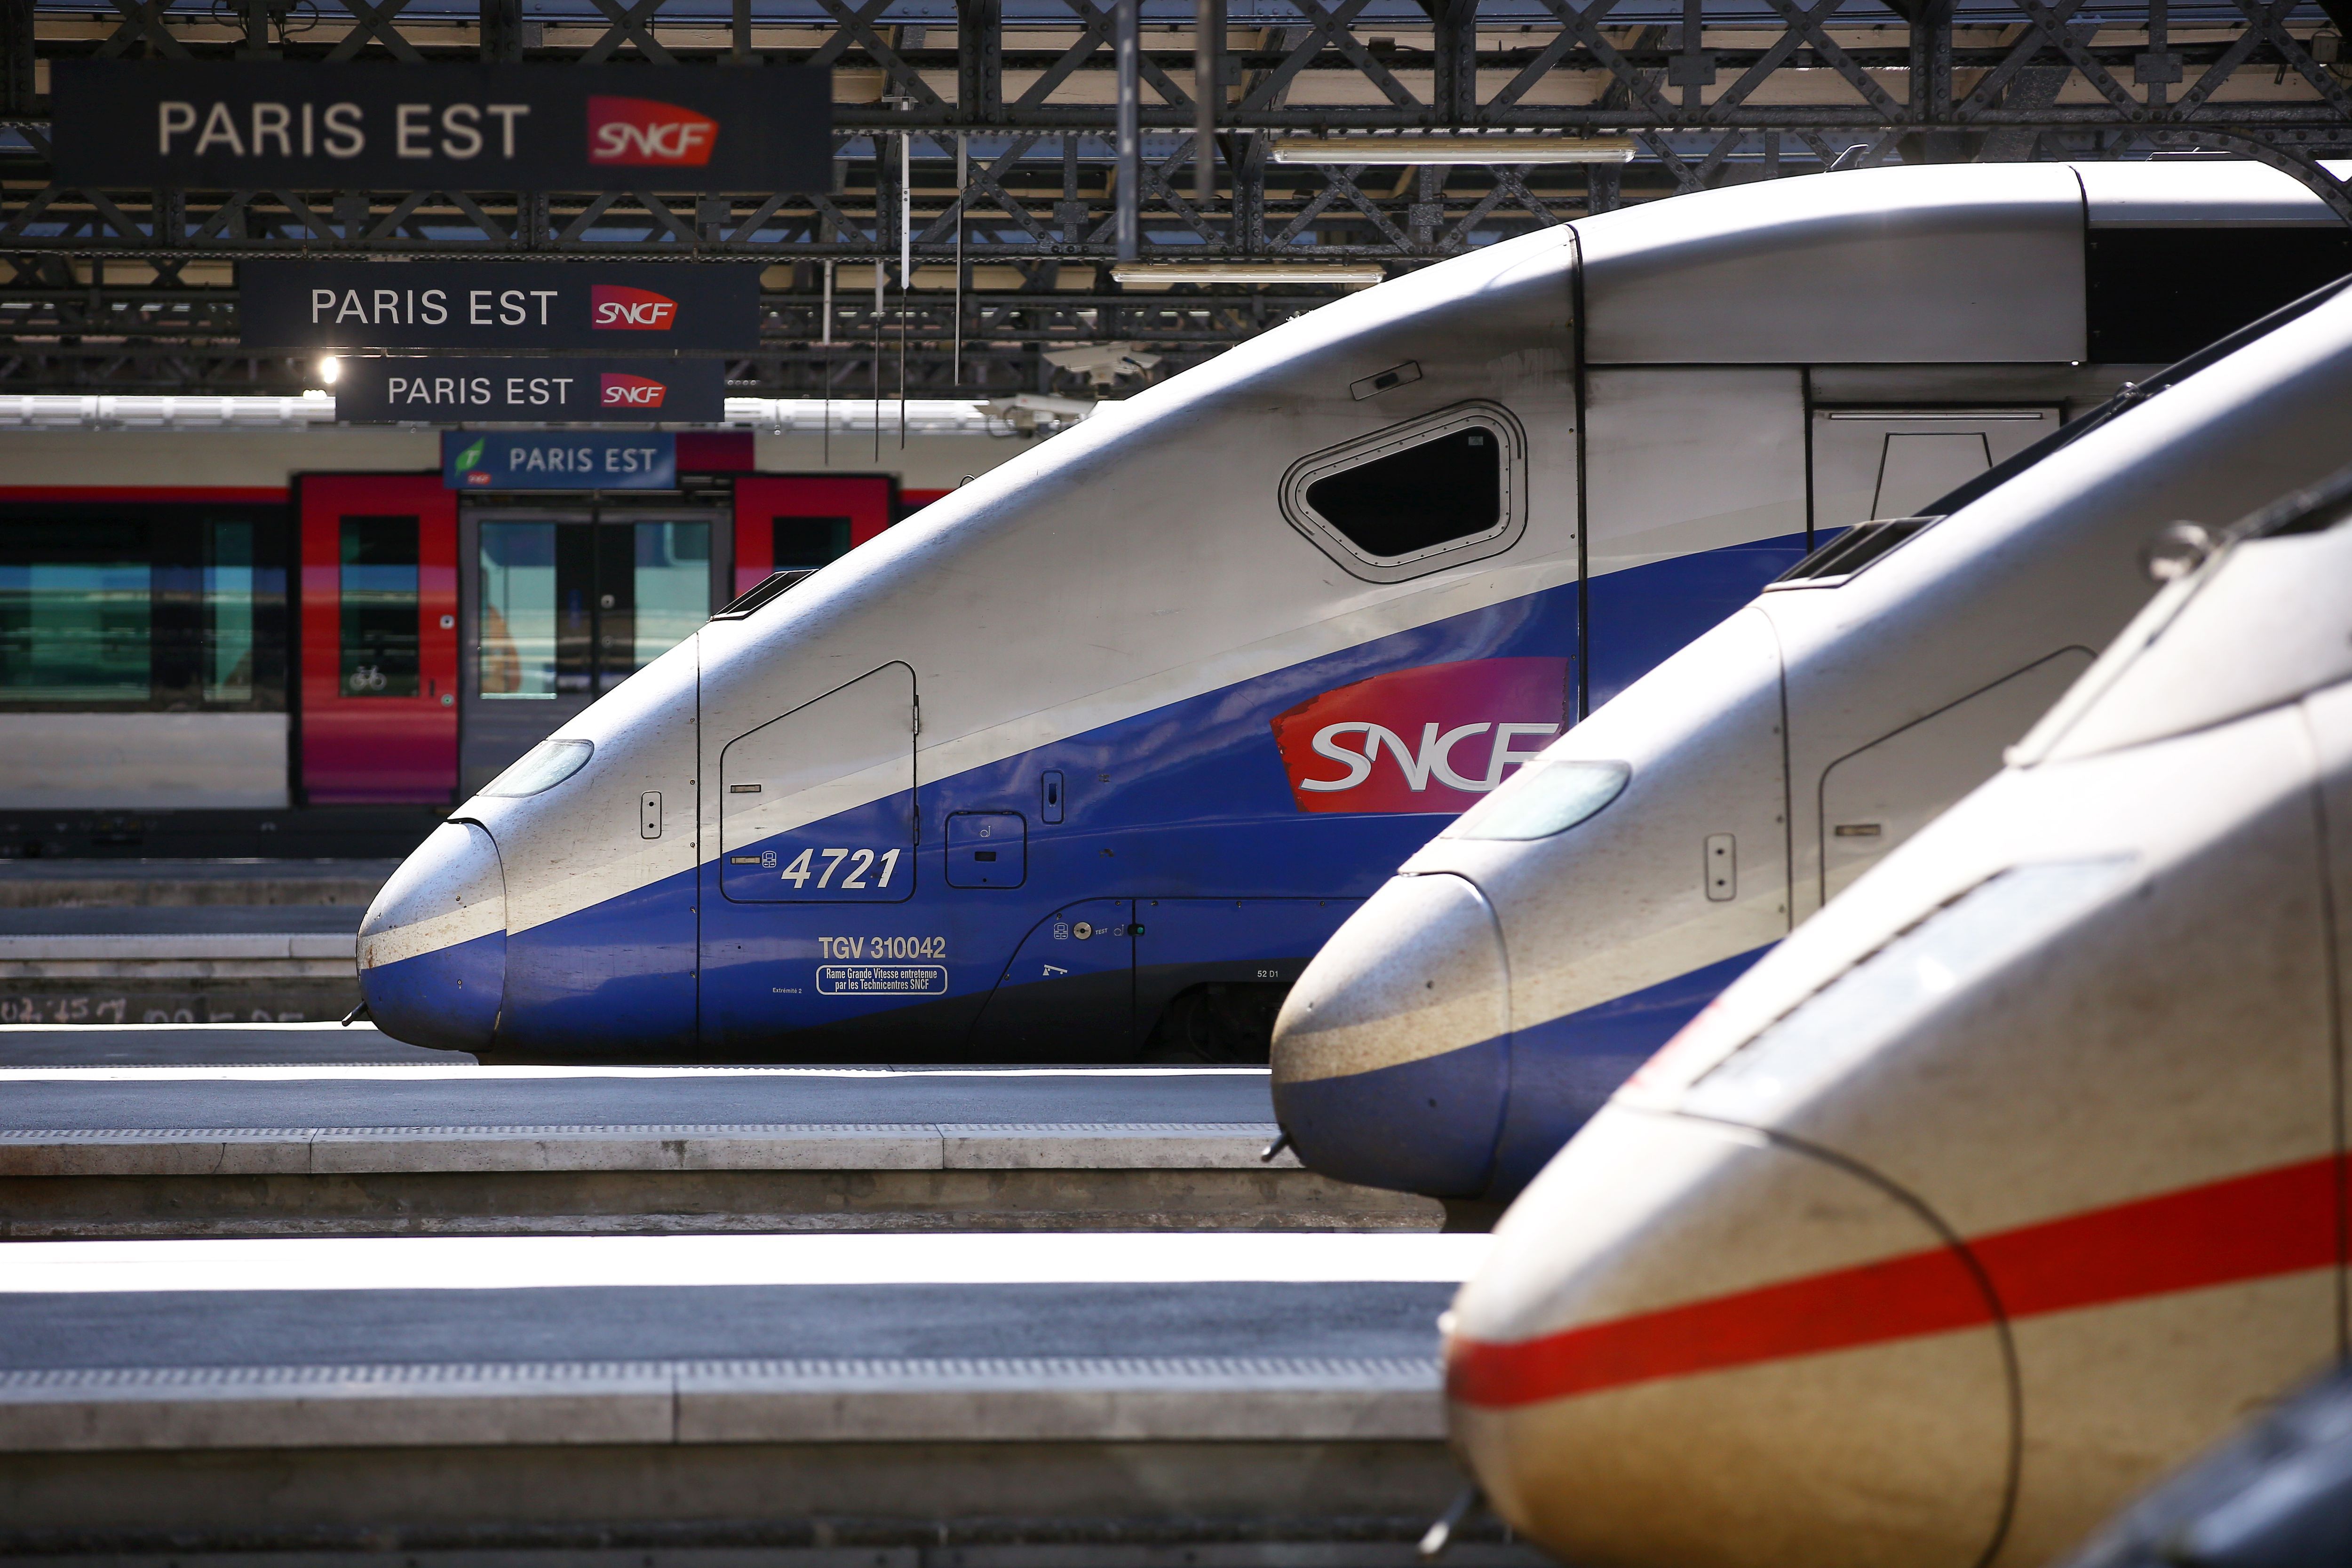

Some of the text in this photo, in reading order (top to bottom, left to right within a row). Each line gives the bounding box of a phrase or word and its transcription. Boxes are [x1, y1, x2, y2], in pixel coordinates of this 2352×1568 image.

[159, 102, 531, 159] PARIS EST
[593, 122, 710, 158] SNCF
[312, 289, 558, 326] PARIS EST
[595, 302, 673, 324] SNCF
[388, 377, 574, 405] PARIS EST
[603, 385, 663, 404] SNCF
[509, 447, 658, 472] PARIS EST
[1298, 722, 1560, 792] SNCF
[781, 848, 901, 889] 4721
[818, 936, 946, 959] TGV 310042
[826, 968, 937, 979] Rame Grande Vitesse entretenue
[835, 979, 929, 992] par les Technicentres SNCF
